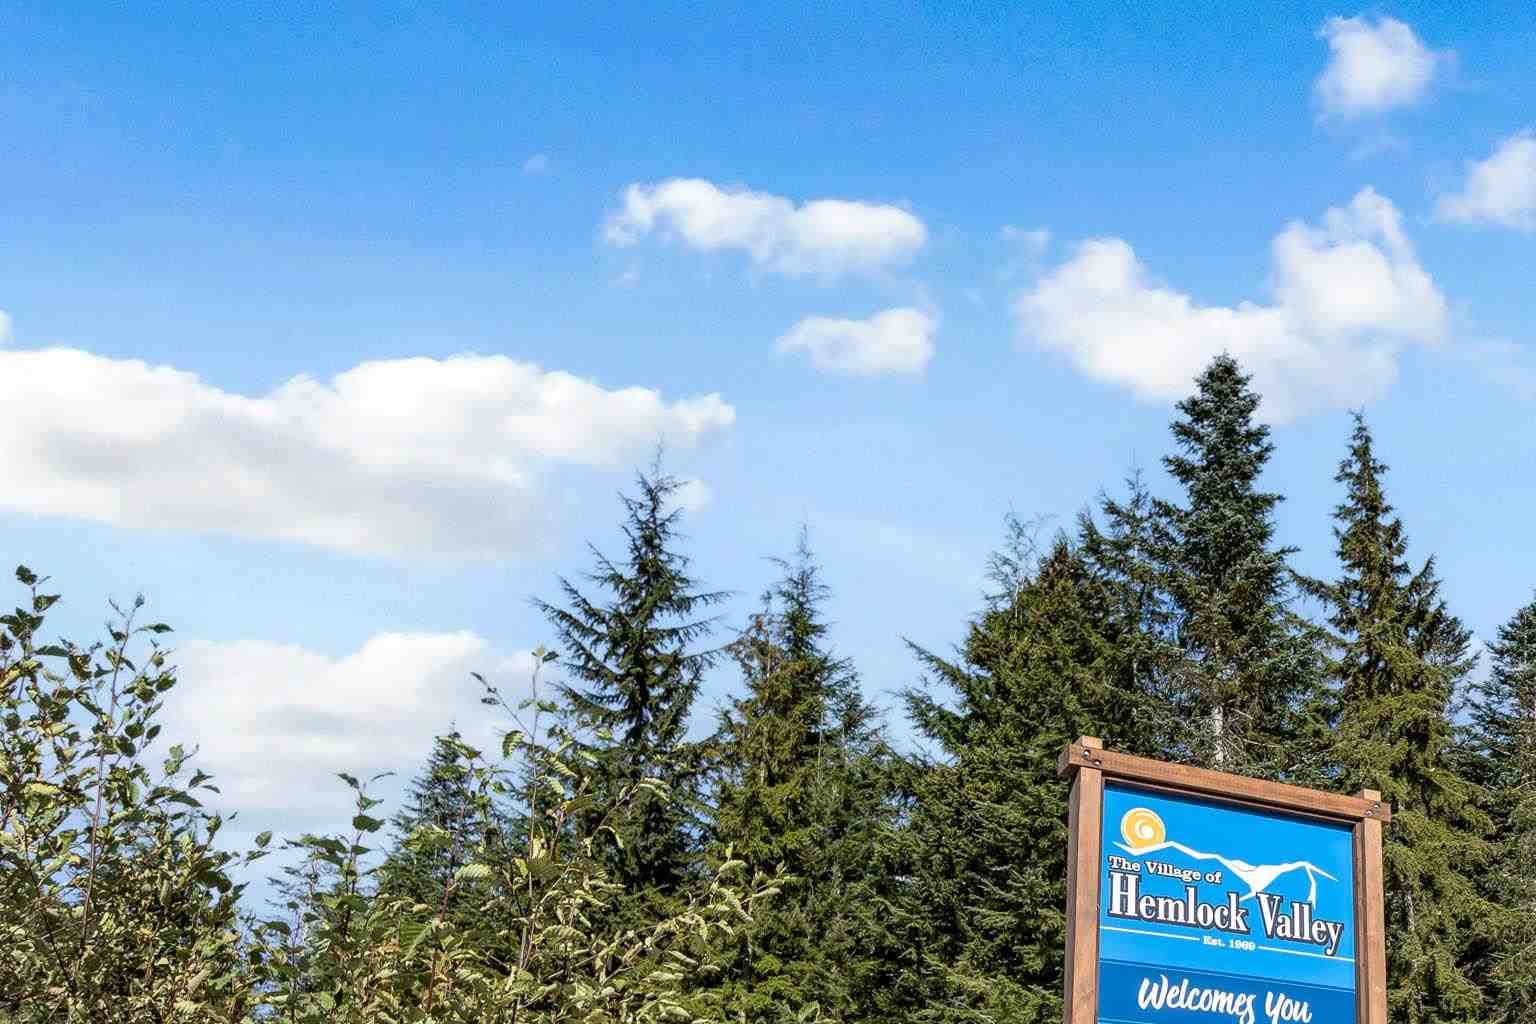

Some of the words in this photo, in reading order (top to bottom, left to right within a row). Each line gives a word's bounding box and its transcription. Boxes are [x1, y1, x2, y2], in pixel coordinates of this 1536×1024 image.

[1108, 854, 1141, 872] The
[1145, 861, 1201, 882] Village
[1205, 871, 1222, 883] of
[1108, 871, 1249, 934] Hemlock
[1257, 892, 1344, 956] Valley
[1203, 936, 1226, 947] Est.
